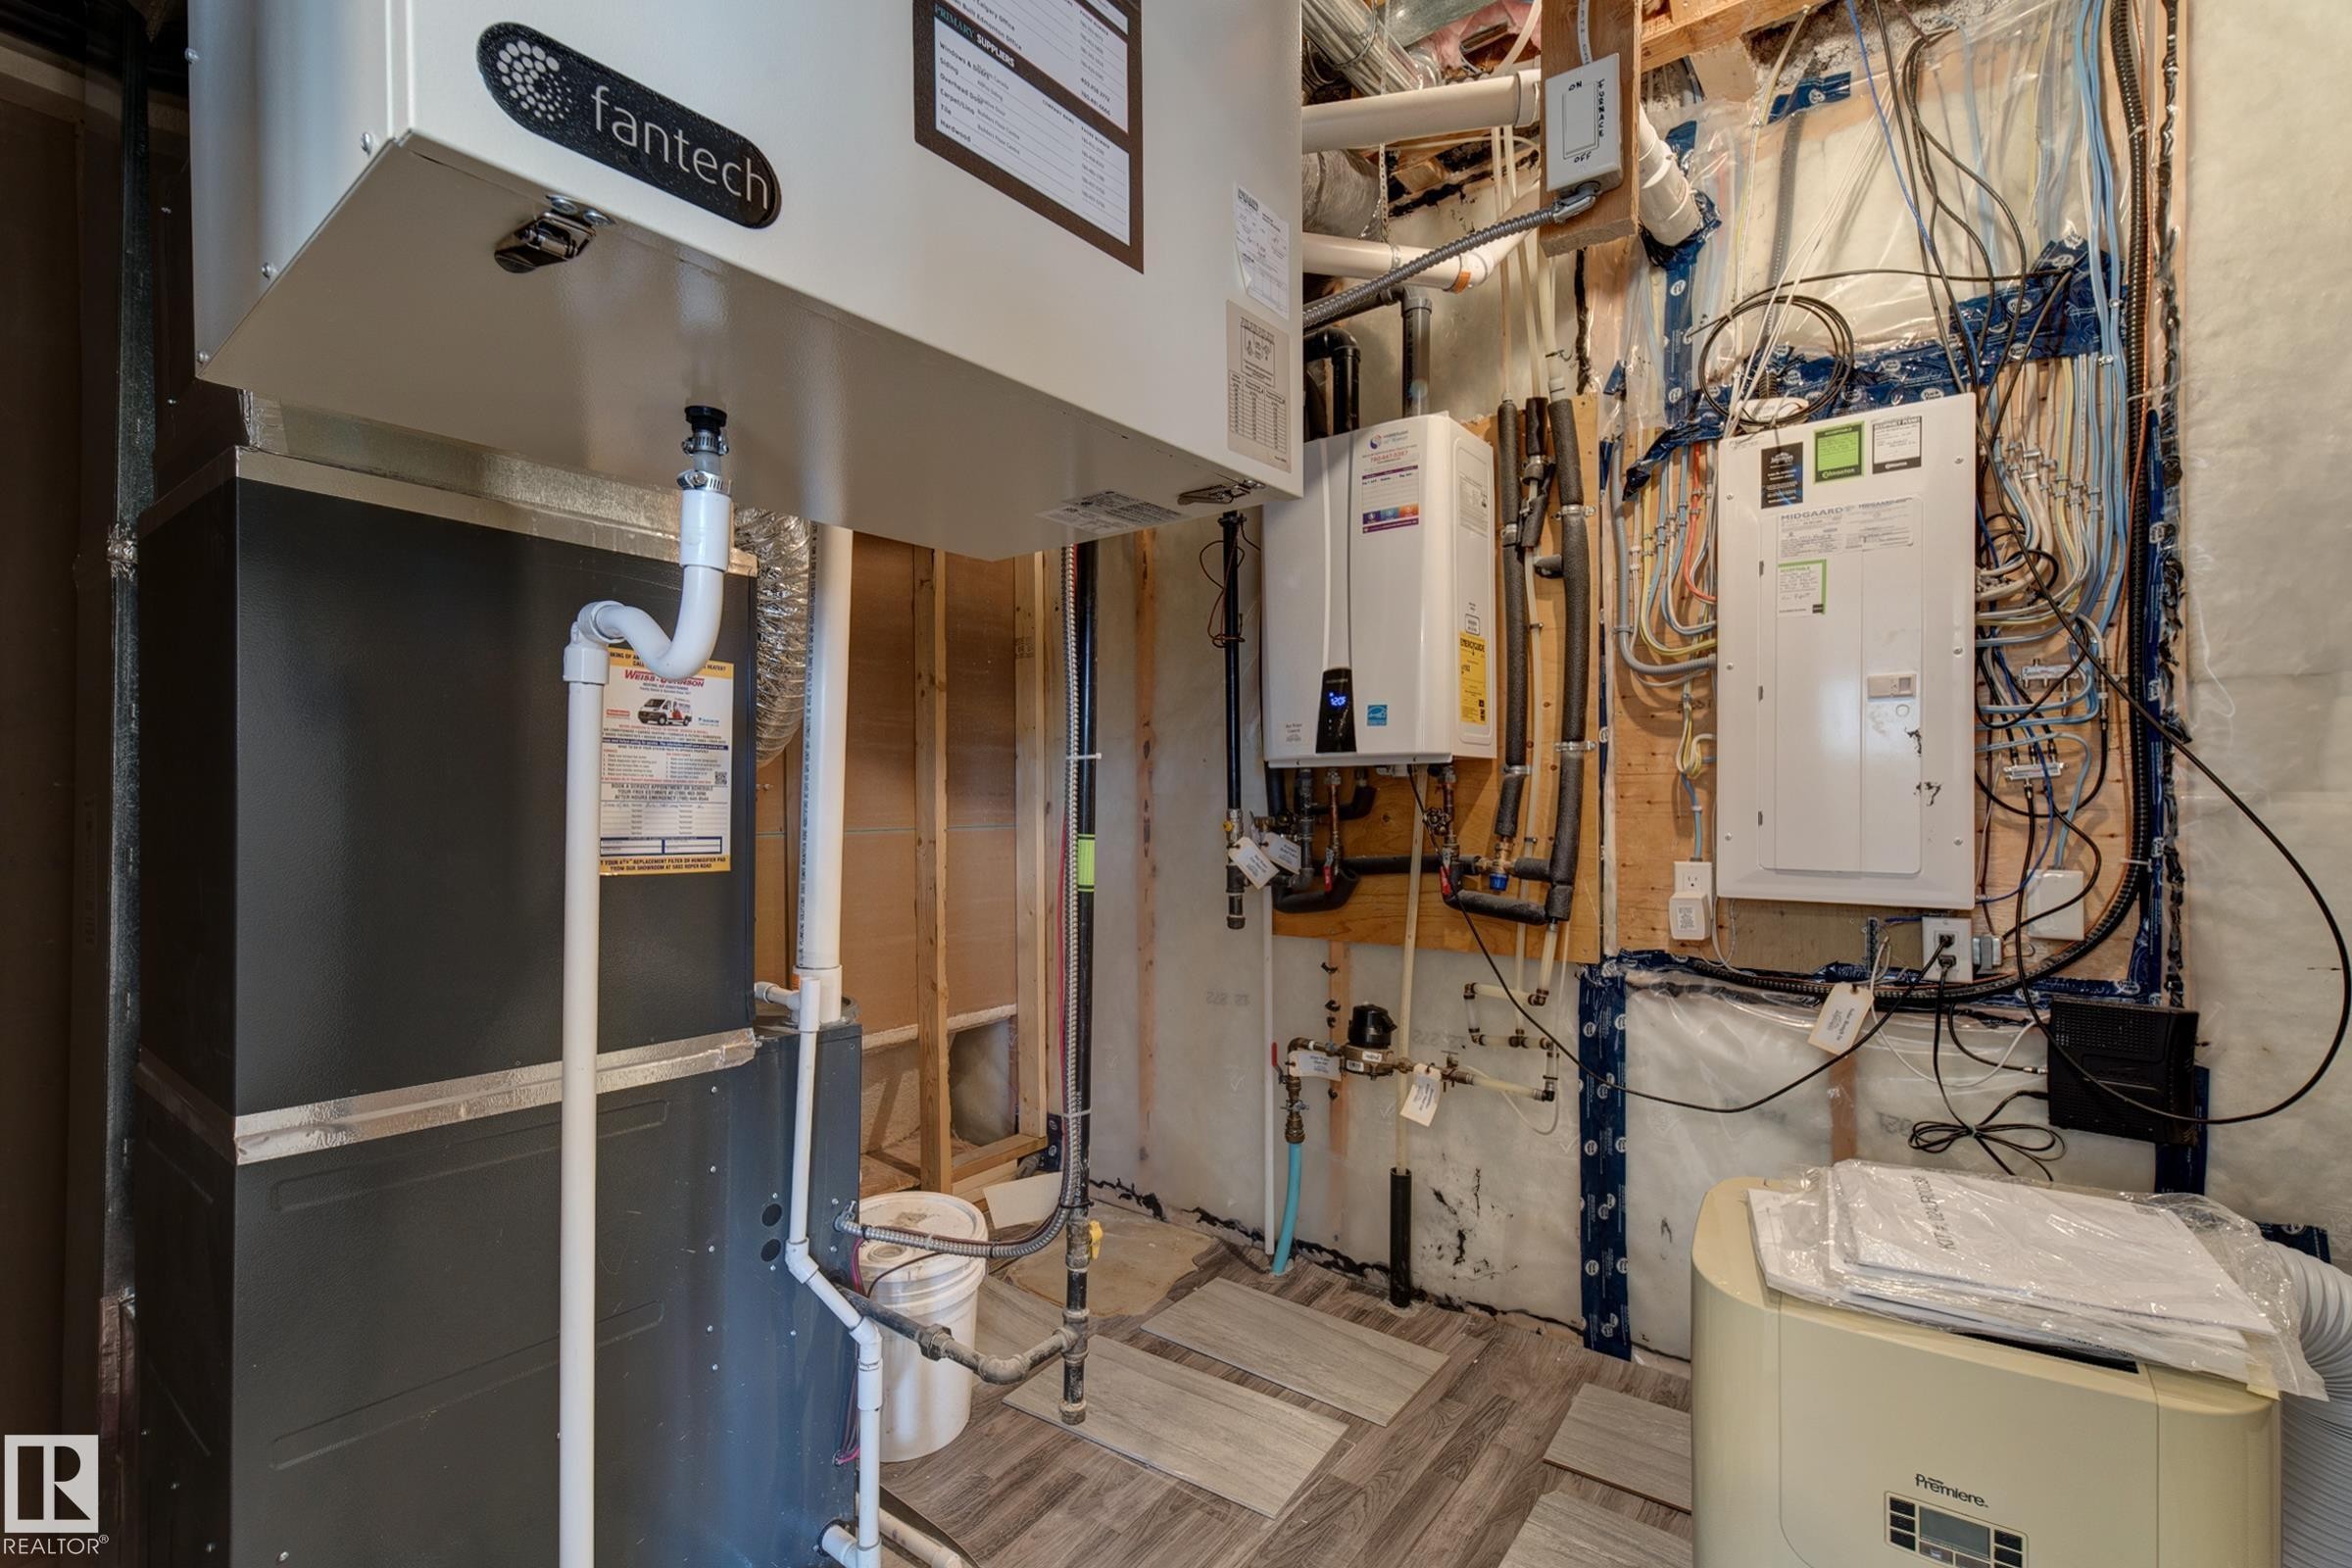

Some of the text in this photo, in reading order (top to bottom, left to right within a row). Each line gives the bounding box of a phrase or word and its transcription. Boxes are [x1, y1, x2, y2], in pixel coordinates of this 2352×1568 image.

[934, 3, 1015, 68] PRIMARY SUPPLIERS
[939, 41, 966, 65] Windows
[939, 73, 969, 96] Overhead
[1568, 80, 1583, 91] ON
[1596, 78, 1606, 137] FURNACE
[591, 85, 769, 211] fantech
[1574, 151, 1592, 164] OFF
[1781, 506, 1843, 520] MIDGAARD
[1915, 1473, 1985, 1508] Premiere
